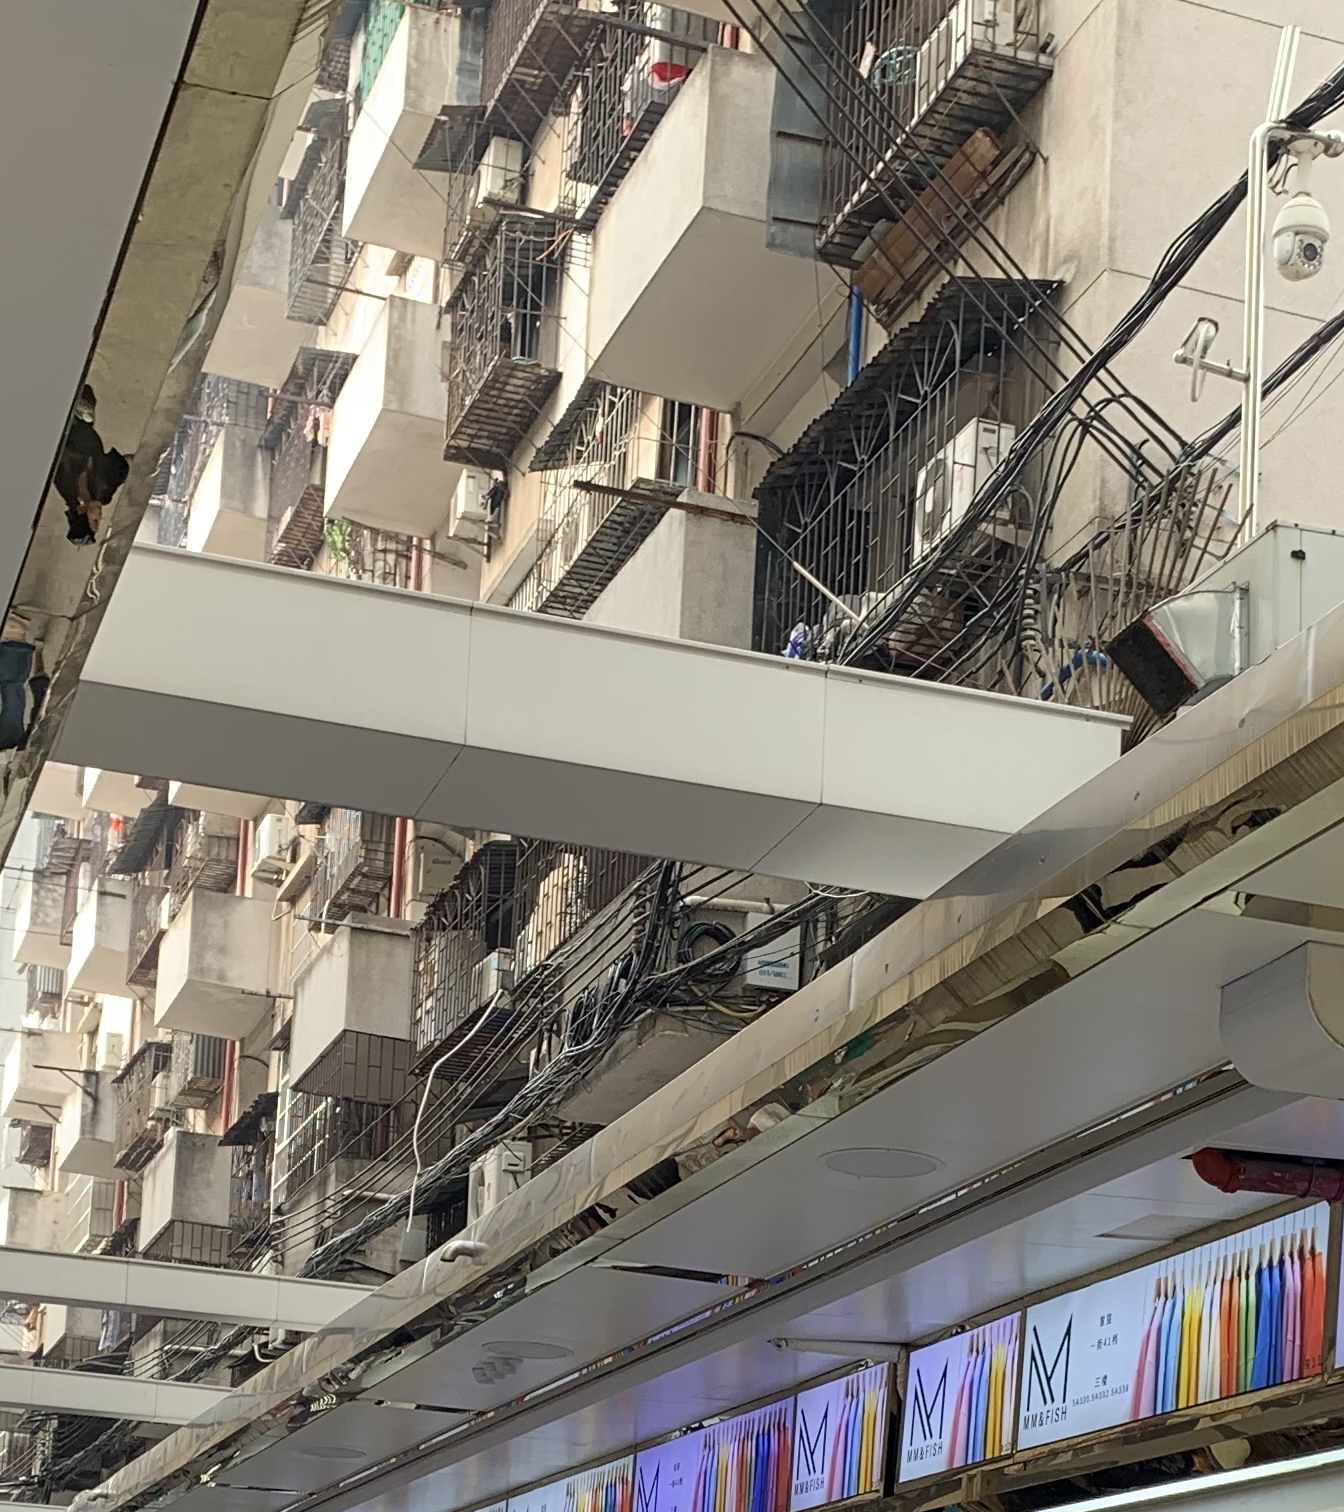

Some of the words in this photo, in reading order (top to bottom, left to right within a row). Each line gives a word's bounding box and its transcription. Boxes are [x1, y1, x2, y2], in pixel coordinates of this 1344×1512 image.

[1022, 1405, 1068, 1431] MM&FISH
[906, 1442, 943, 1464] MM&FISH
[794, 1476, 825, 1497] MM&FISH
